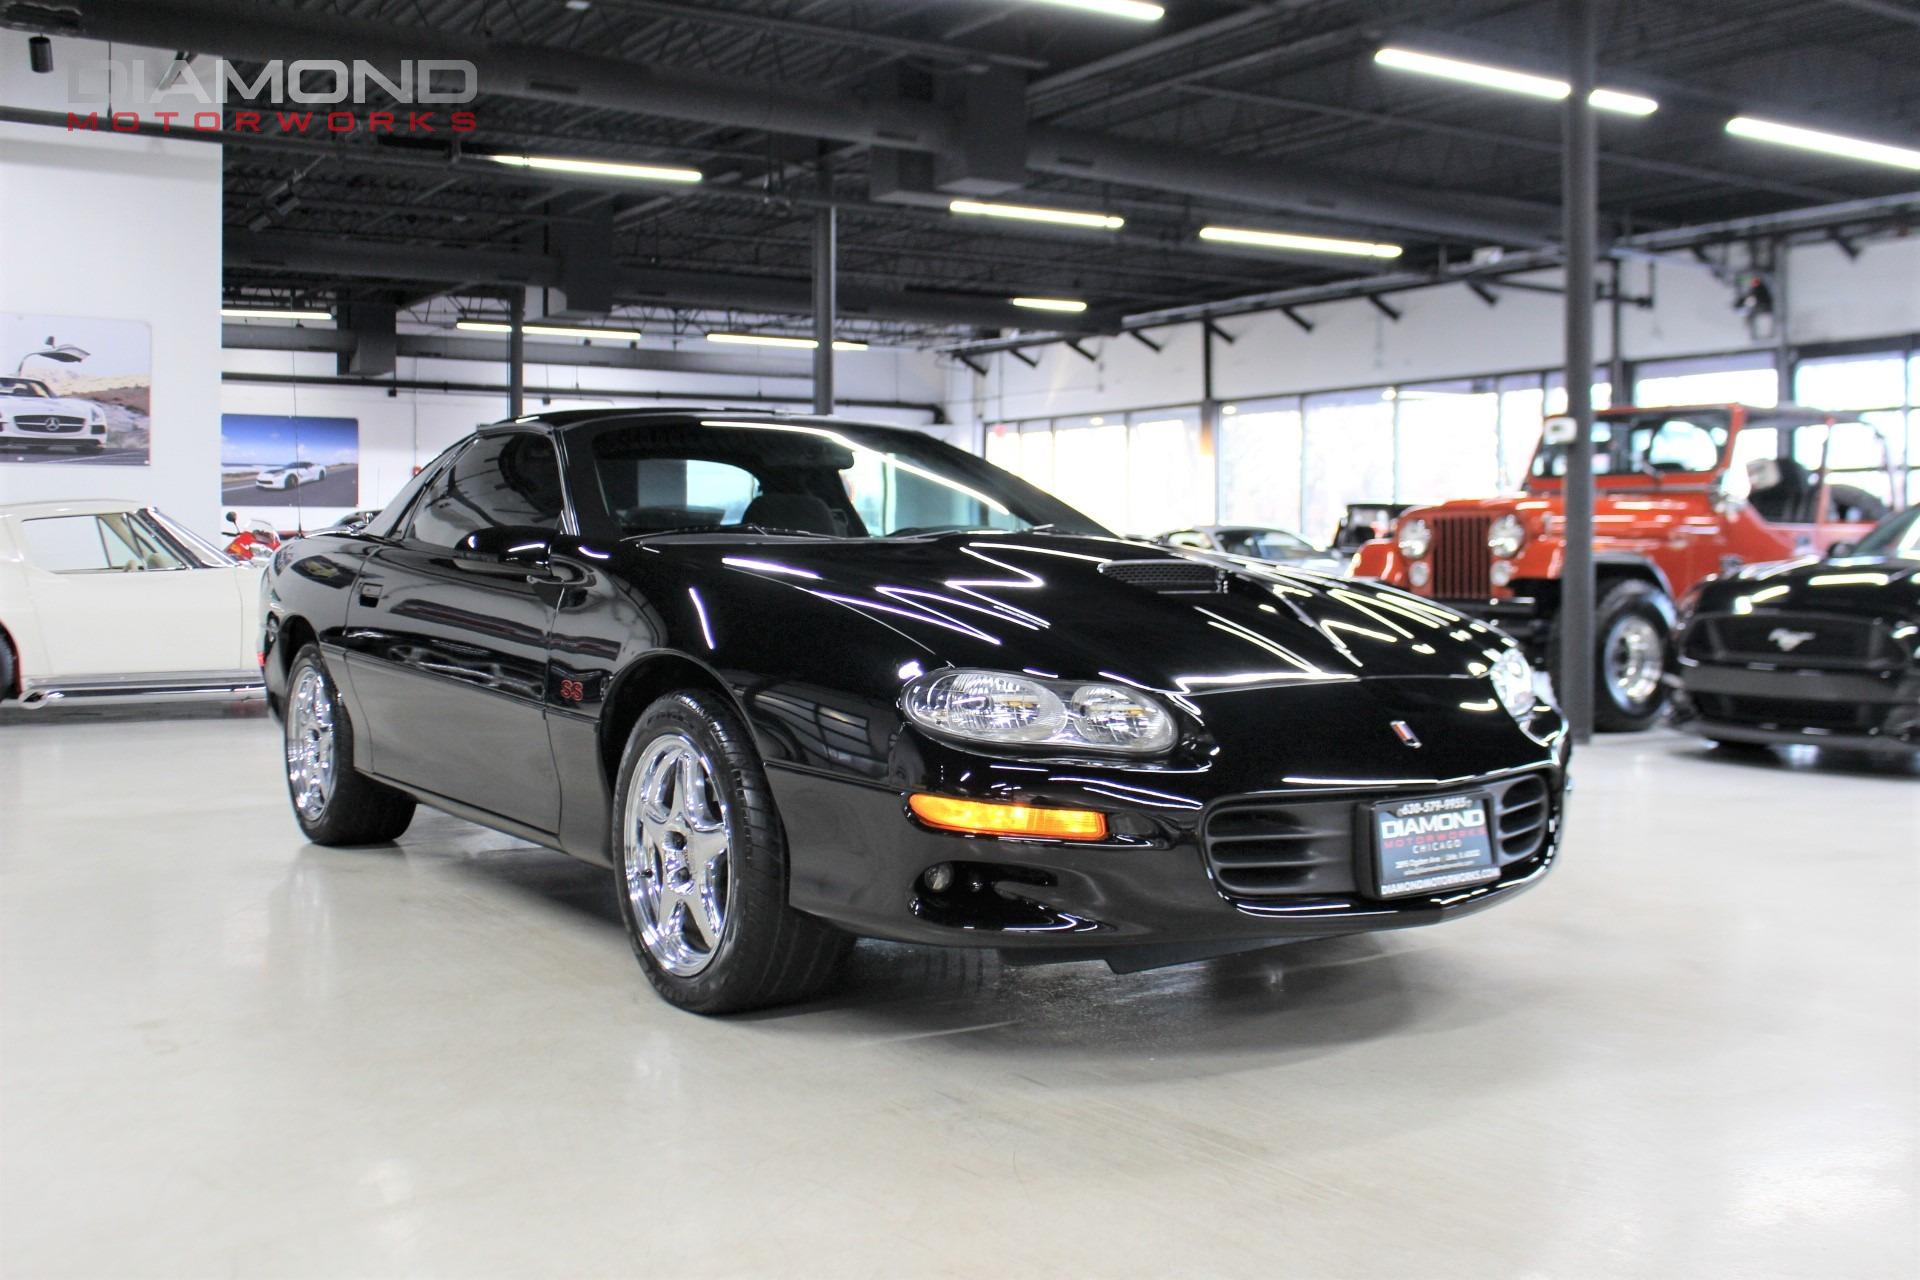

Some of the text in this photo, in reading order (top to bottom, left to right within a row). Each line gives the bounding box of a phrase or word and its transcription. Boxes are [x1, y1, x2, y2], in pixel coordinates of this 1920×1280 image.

[561, 679, 584, 701] SS
[1381, 809, 1485, 839] DIAMOND
[1383, 826, 1488, 848] MOTORWORKS
[1412, 839, 1462, 854] CHICAGO
